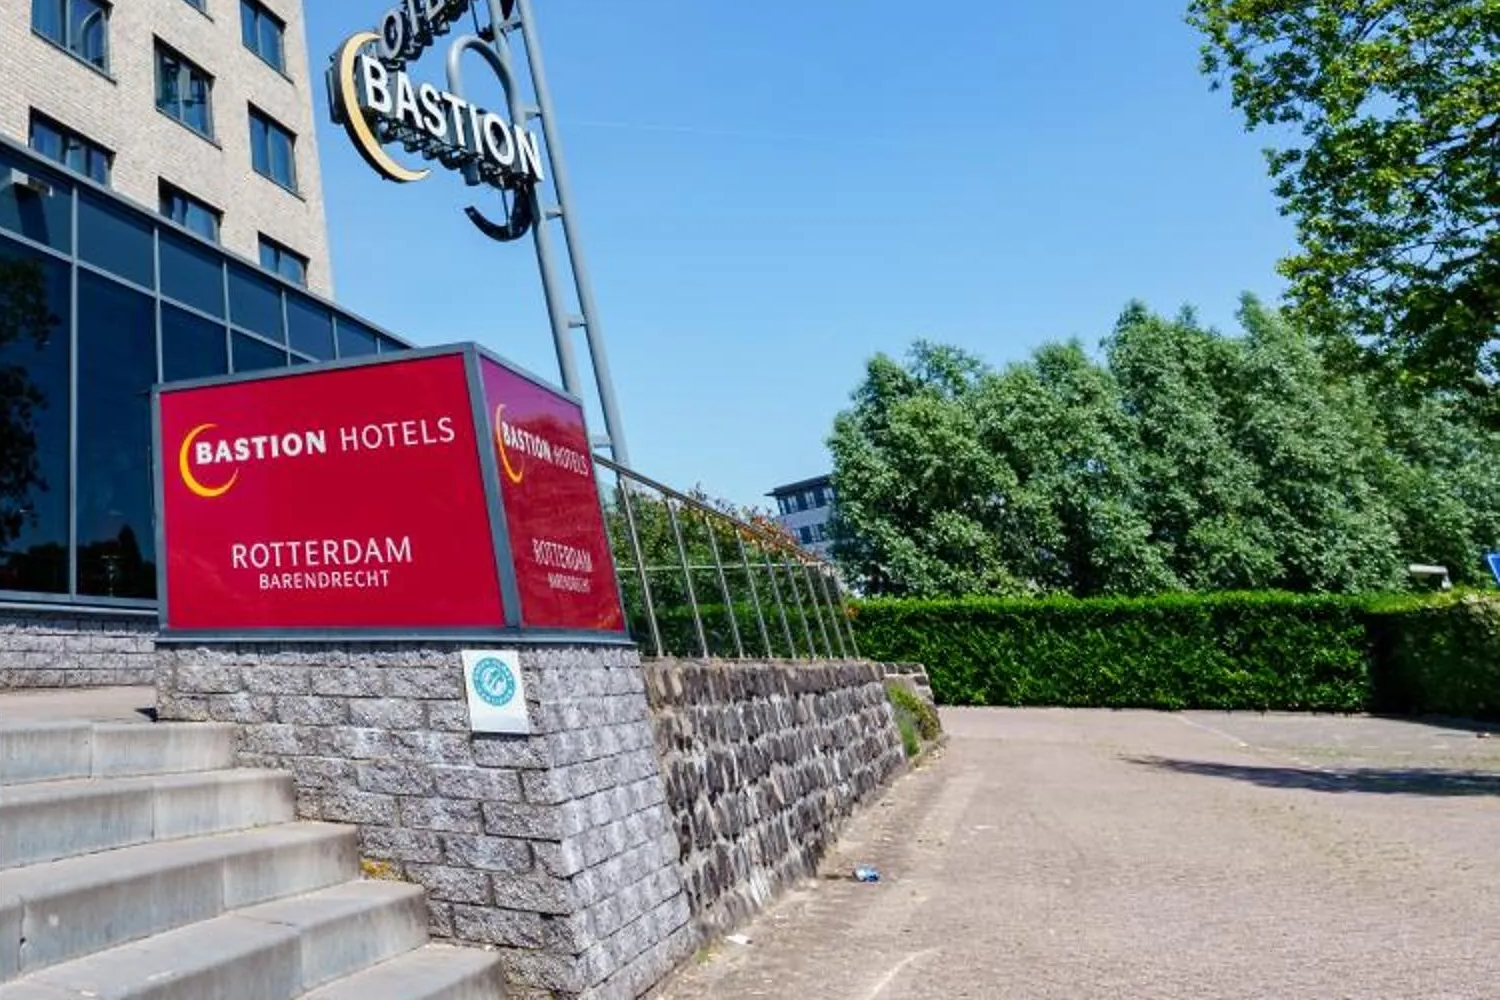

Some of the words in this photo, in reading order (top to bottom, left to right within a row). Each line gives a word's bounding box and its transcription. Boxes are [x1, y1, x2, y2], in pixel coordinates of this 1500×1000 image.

[361, 54, 543, 182] BASTION
[195, 430, 327, 465] BASTION
[340, 416, 456, 451] HOTELS
[231, 536, 414, 569] ROTTERDAM
[259, 569, 390, 590] BARENDRECHT
